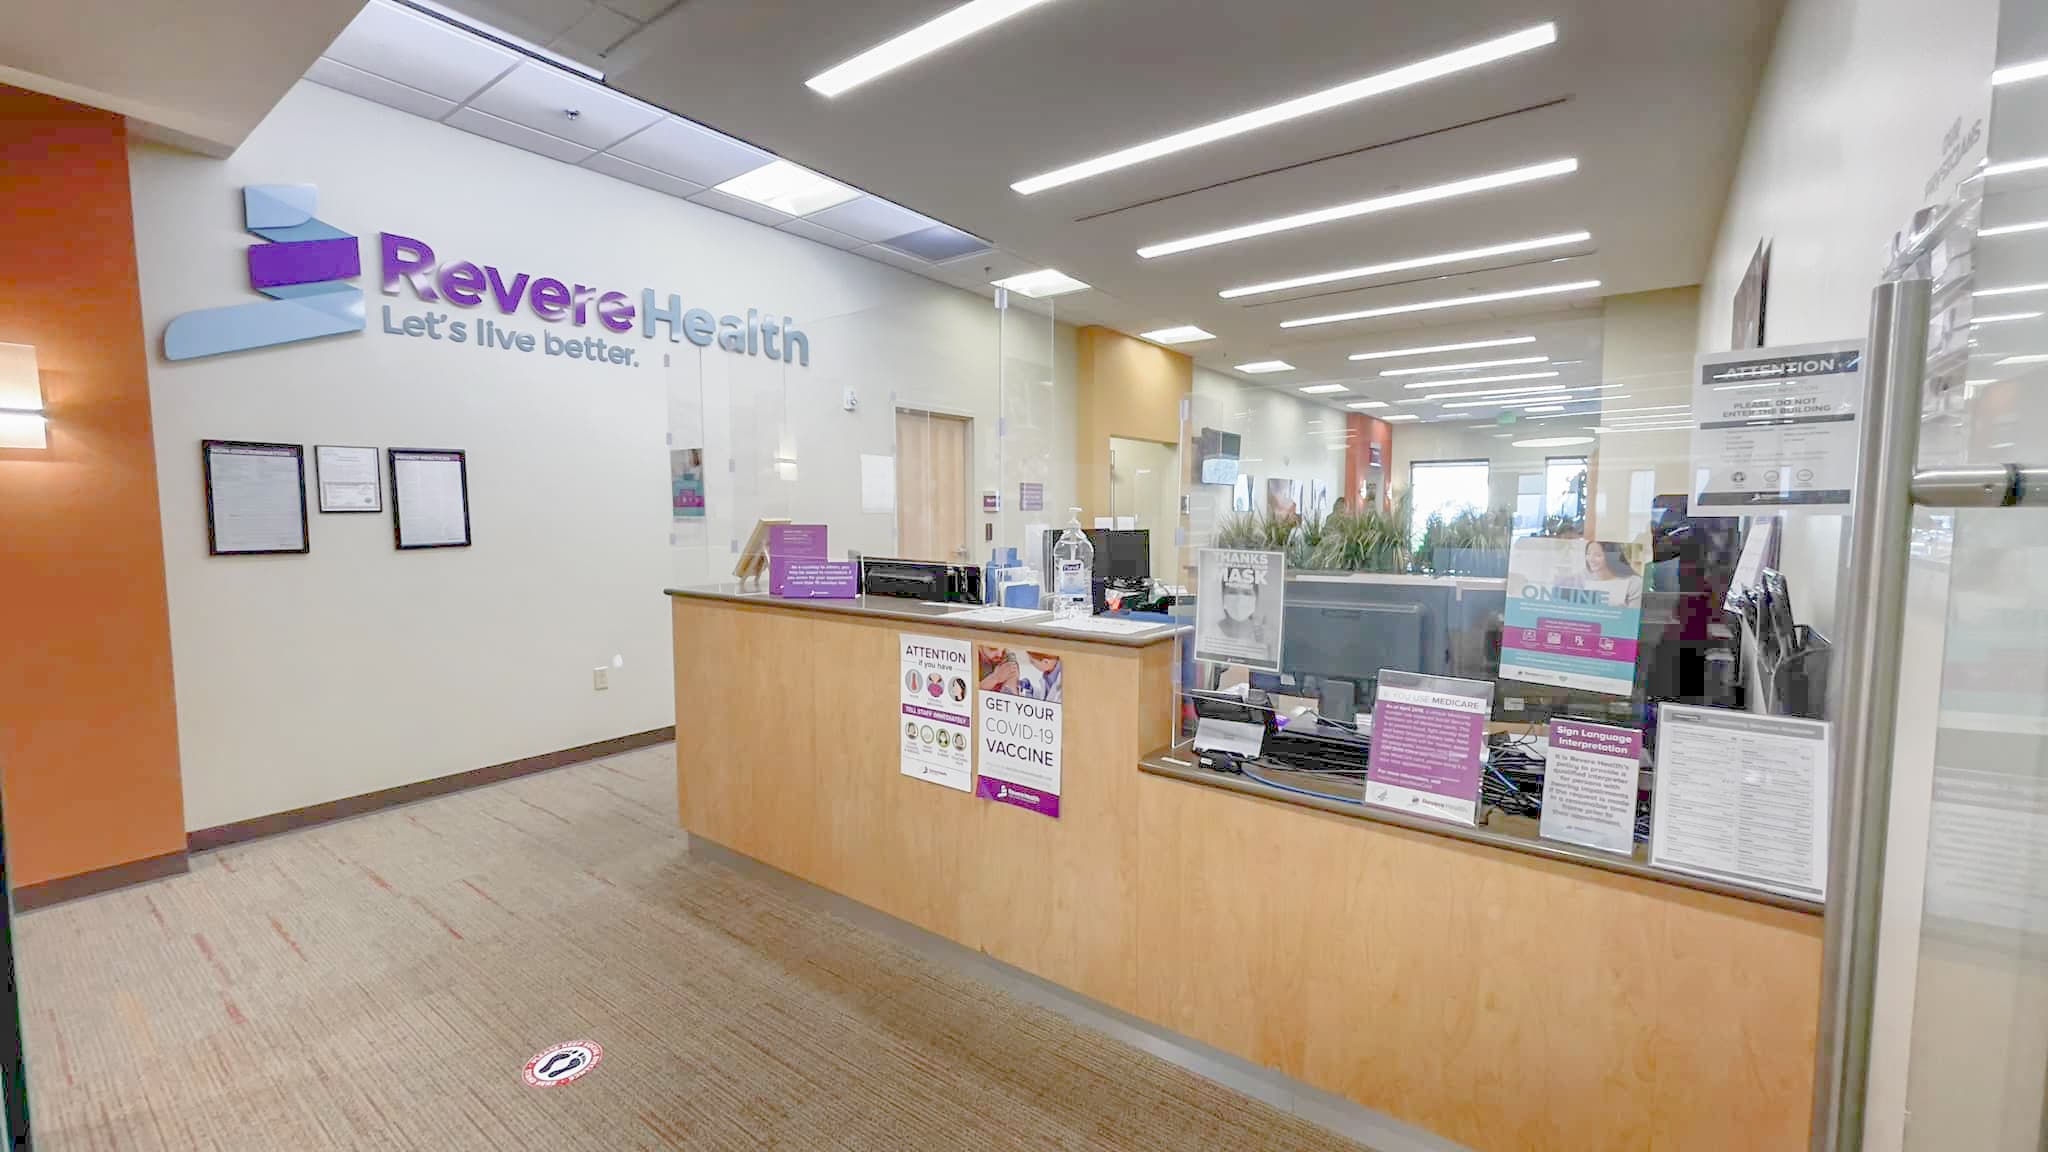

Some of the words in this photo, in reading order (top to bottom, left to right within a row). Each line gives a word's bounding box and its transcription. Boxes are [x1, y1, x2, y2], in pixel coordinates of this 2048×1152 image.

[382, 304, 467, 343] Let's
[477, 318, 536, 352] live
[544, 328, 639, 367] better.
[1725, 359, 1835, 380] ATTENTION
[1794, 397, 1817, 406] NOT
[1215, 551, 1268, 565] THANKS
[1522, 584, 1610, 605] ONLINE
[905, 644, 967, 664] ATTENTION
[918, 658, 924, 666] if
[924, 660, 936, 670] you
[937, 661, 953, 671] have
[985, 697, 1011, 712] GET
[1015, 703, 1054, 722] YOUR
[1431, 696, 1479, 710] MEDICARE
[985, 717, 1054, 745] COVID-19
[1557, 725, 1579, 736] Sign
[1581, 729, 1633, 744] Language
[986, 737, 1054, 767] VACCINE
[1559, 737, 1628, 754] Interpretation
